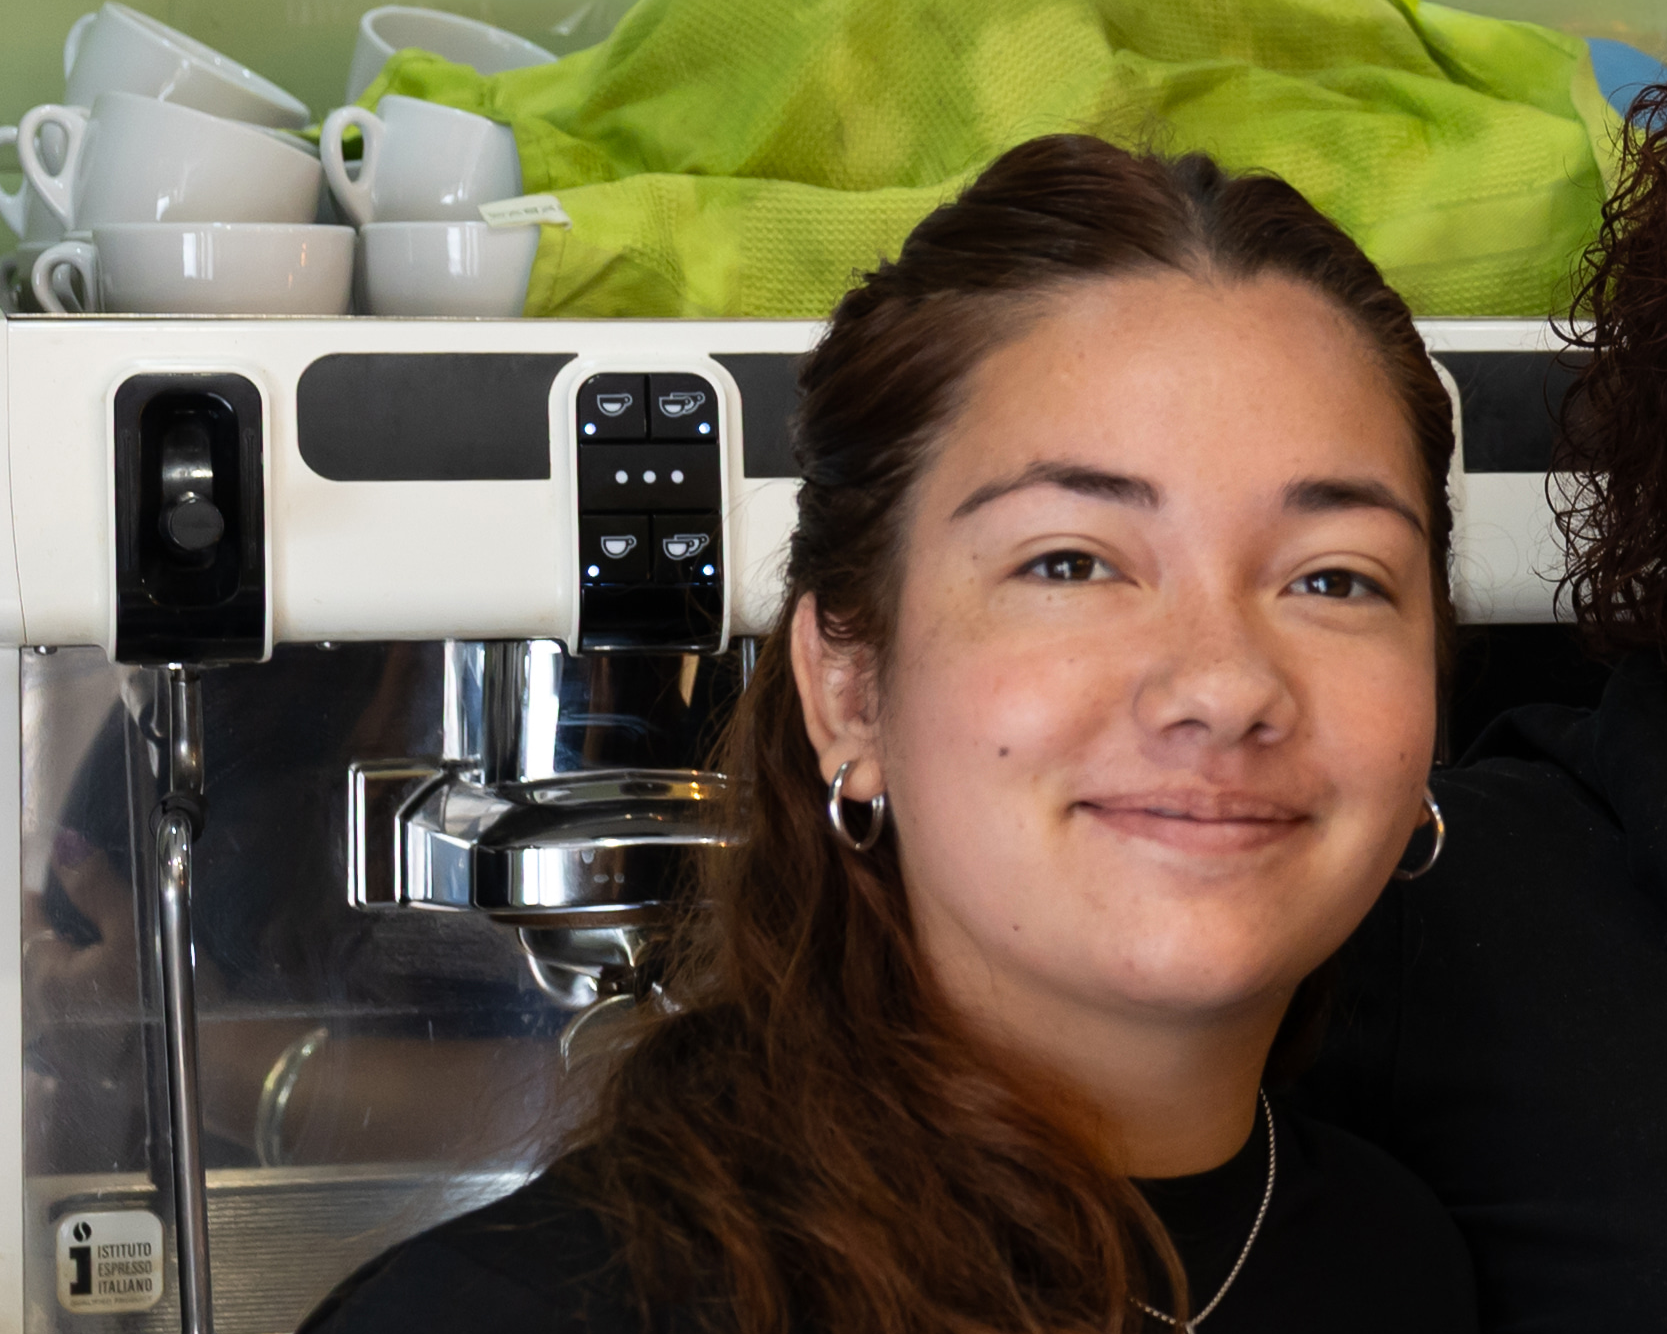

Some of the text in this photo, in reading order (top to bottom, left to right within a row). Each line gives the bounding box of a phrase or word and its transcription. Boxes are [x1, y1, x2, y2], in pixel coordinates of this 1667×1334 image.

[97, 1242, 152, 1258] ISTITUTO
[97, 1259, 153, 1277] ESPRESSO
[98, 1277, 153, 1295] ITALIANO
